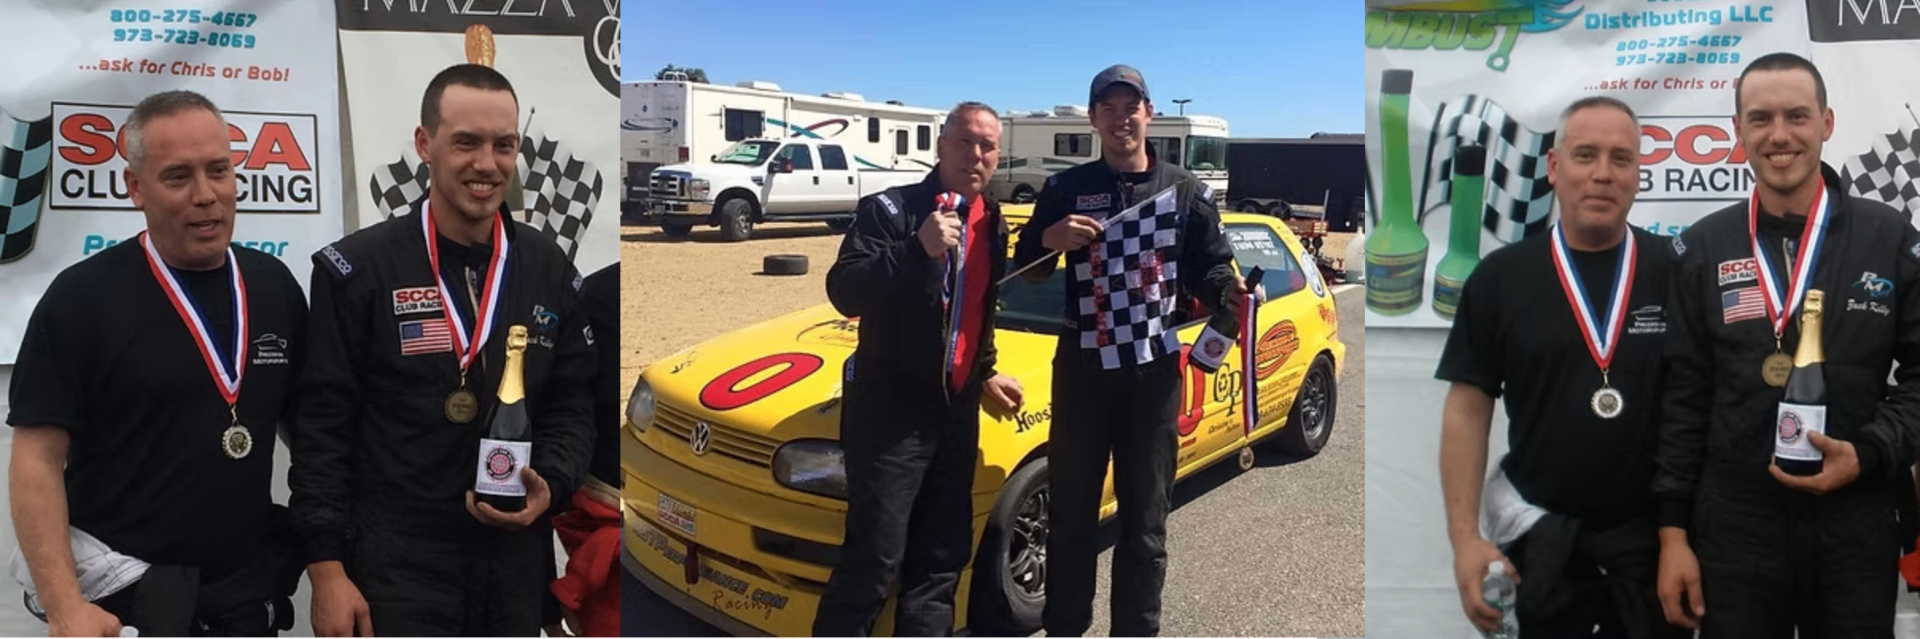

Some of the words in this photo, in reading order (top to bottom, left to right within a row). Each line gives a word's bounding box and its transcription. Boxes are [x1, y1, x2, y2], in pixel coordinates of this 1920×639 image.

[110, 9, 257, 27] 800-275-4667
[1585, 9, 1722, 29] Distributing
[1729, 5, 1773, 22] LLC
[113, 28, 255, 48] 973-723-8069
[1616, 35, 1742, 51] 800-275-4667
[1615, 53, 1740, 66] 973-723-8069
[139, 59, 165, 74] for
[171, 62, 215, 77] Chris
[222, 66, 242, 78] or
[248, 66, 289, 81] Bob!
[1634, 78, 1657, 90] for
[1663, 78, 1703, 90] Chris
[1710, 79, 1727, 90] or
[1720, 260, 1755, 275] SCC
